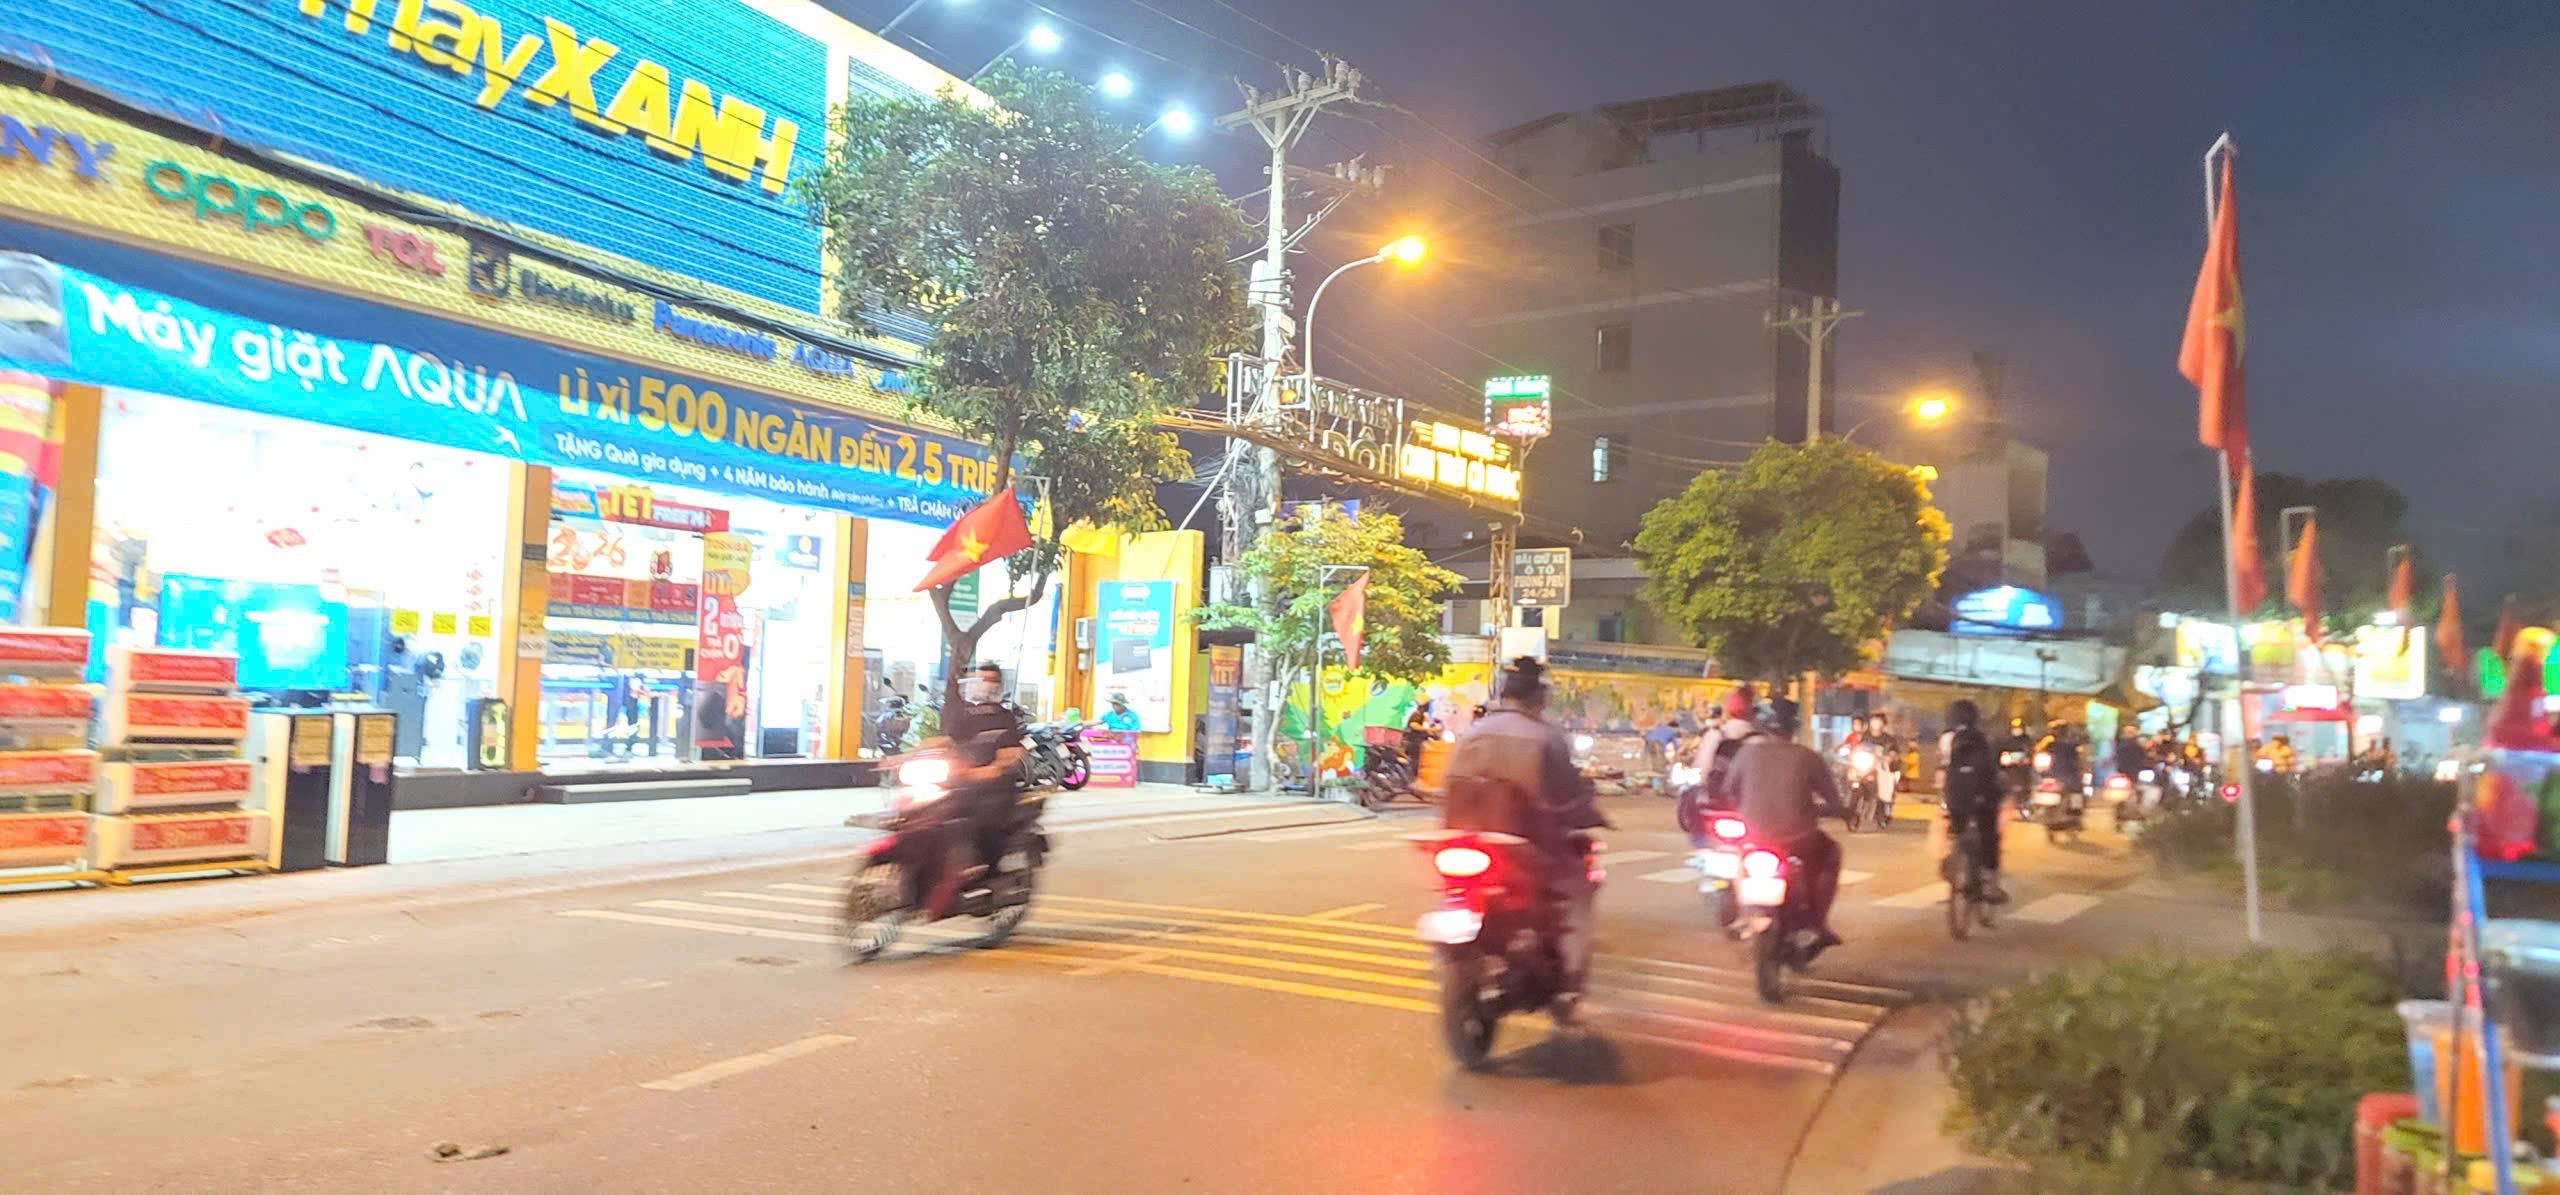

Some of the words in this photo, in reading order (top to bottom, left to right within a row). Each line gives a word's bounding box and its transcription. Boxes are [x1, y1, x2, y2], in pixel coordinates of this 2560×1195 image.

[363, 222, 446, 276] TCL
[82, 282, 216, 368] Máy
[231, 325, 348, 391] giặt
[362, 343, 529, 422] AQUA
[654, 300, 777, 358] Panasonic
[792, 342, 854, 378] AQUA
[558, 367, 590, 417] LÌ
[639, 377, 727, 441] 500
[735, 407, 832, 463] NGÀN
[840, 431, 891, 476] ĐẾN
[897, 434, 943, 488] 2,5
[555, 432, 603, 460] TẶNG
[640, 451, 667, 472] gia
[668, 454, 707, 482] dụng
[723, 468, 733, 483] 4
[734, 466, 767, 489] NĂM
[797, 478, 830, 499] hành
[898, 494, 919, 514] TRẢ
[1552, 554, 1564, 564] XE
